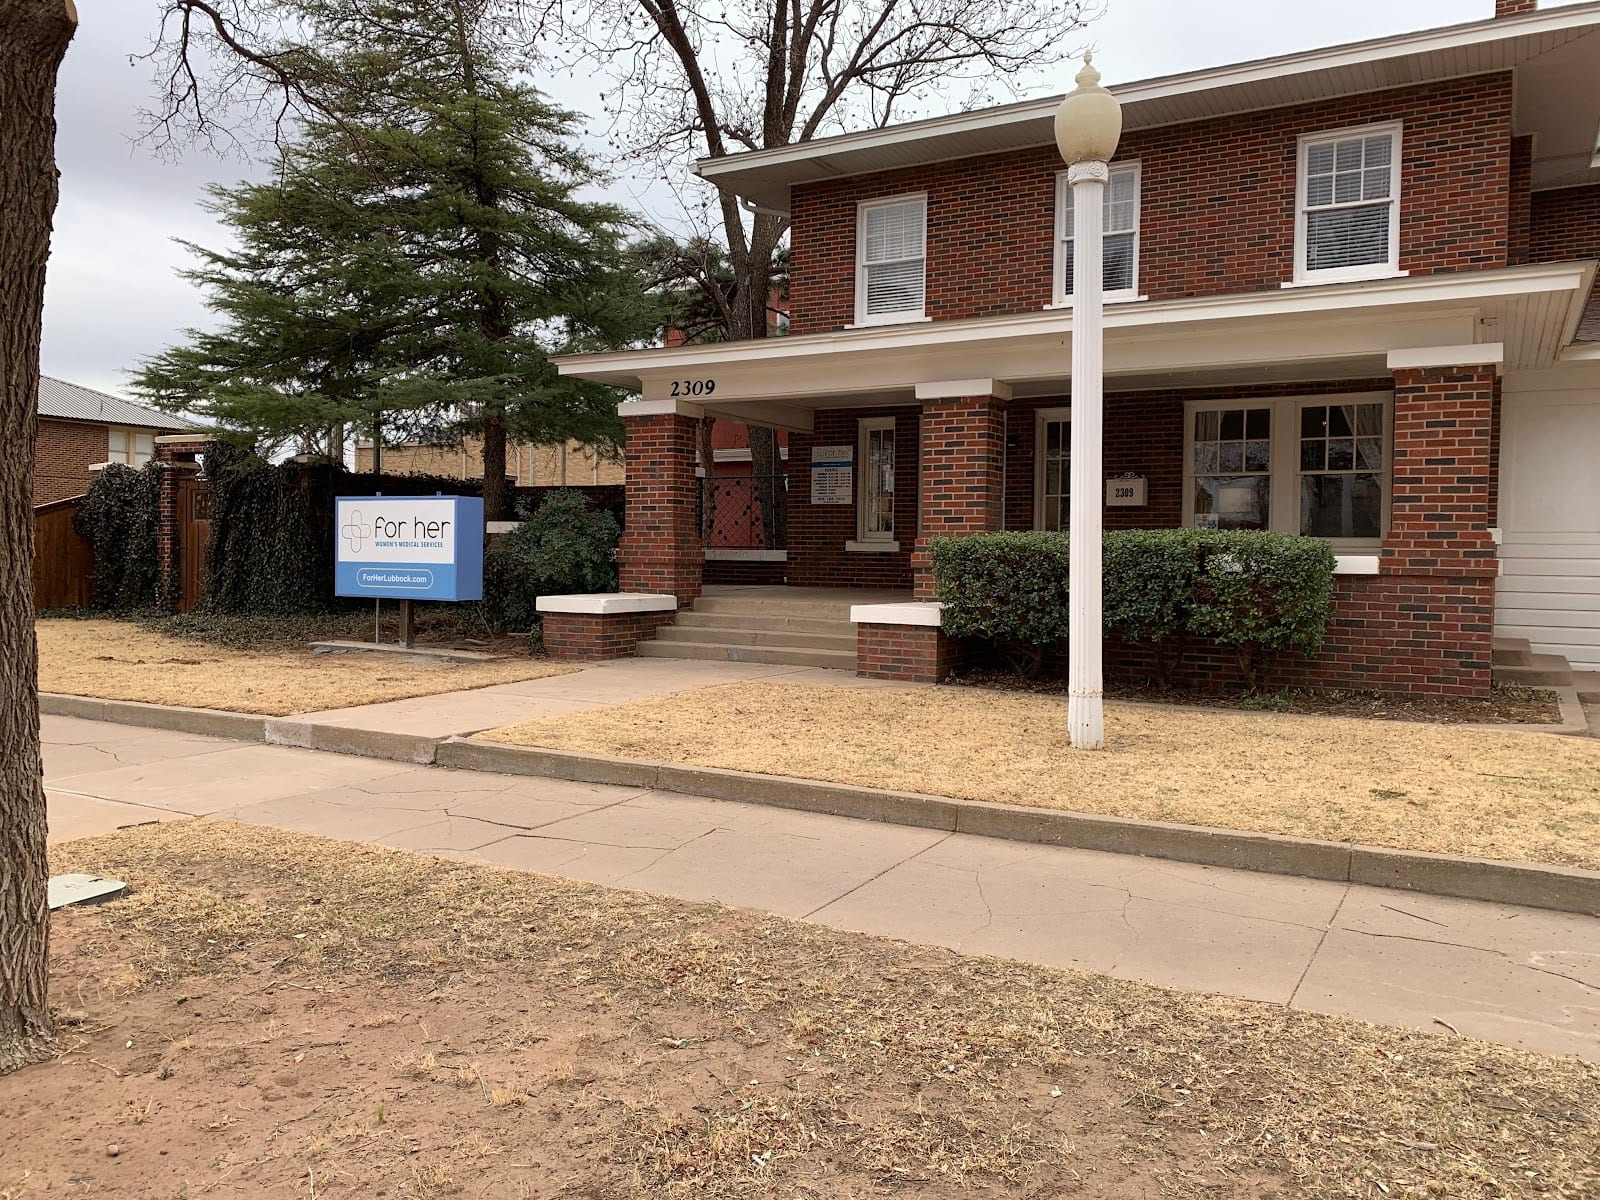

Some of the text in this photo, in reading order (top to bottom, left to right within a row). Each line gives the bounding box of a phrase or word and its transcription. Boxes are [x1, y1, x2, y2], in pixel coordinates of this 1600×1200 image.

[670, 379, 716, 397] 2309
[1115, 487, 1134, 498] 2309
[375, 516, 451, 539] for her
[362, 573, 427, 584] ForHerLubbock.com
